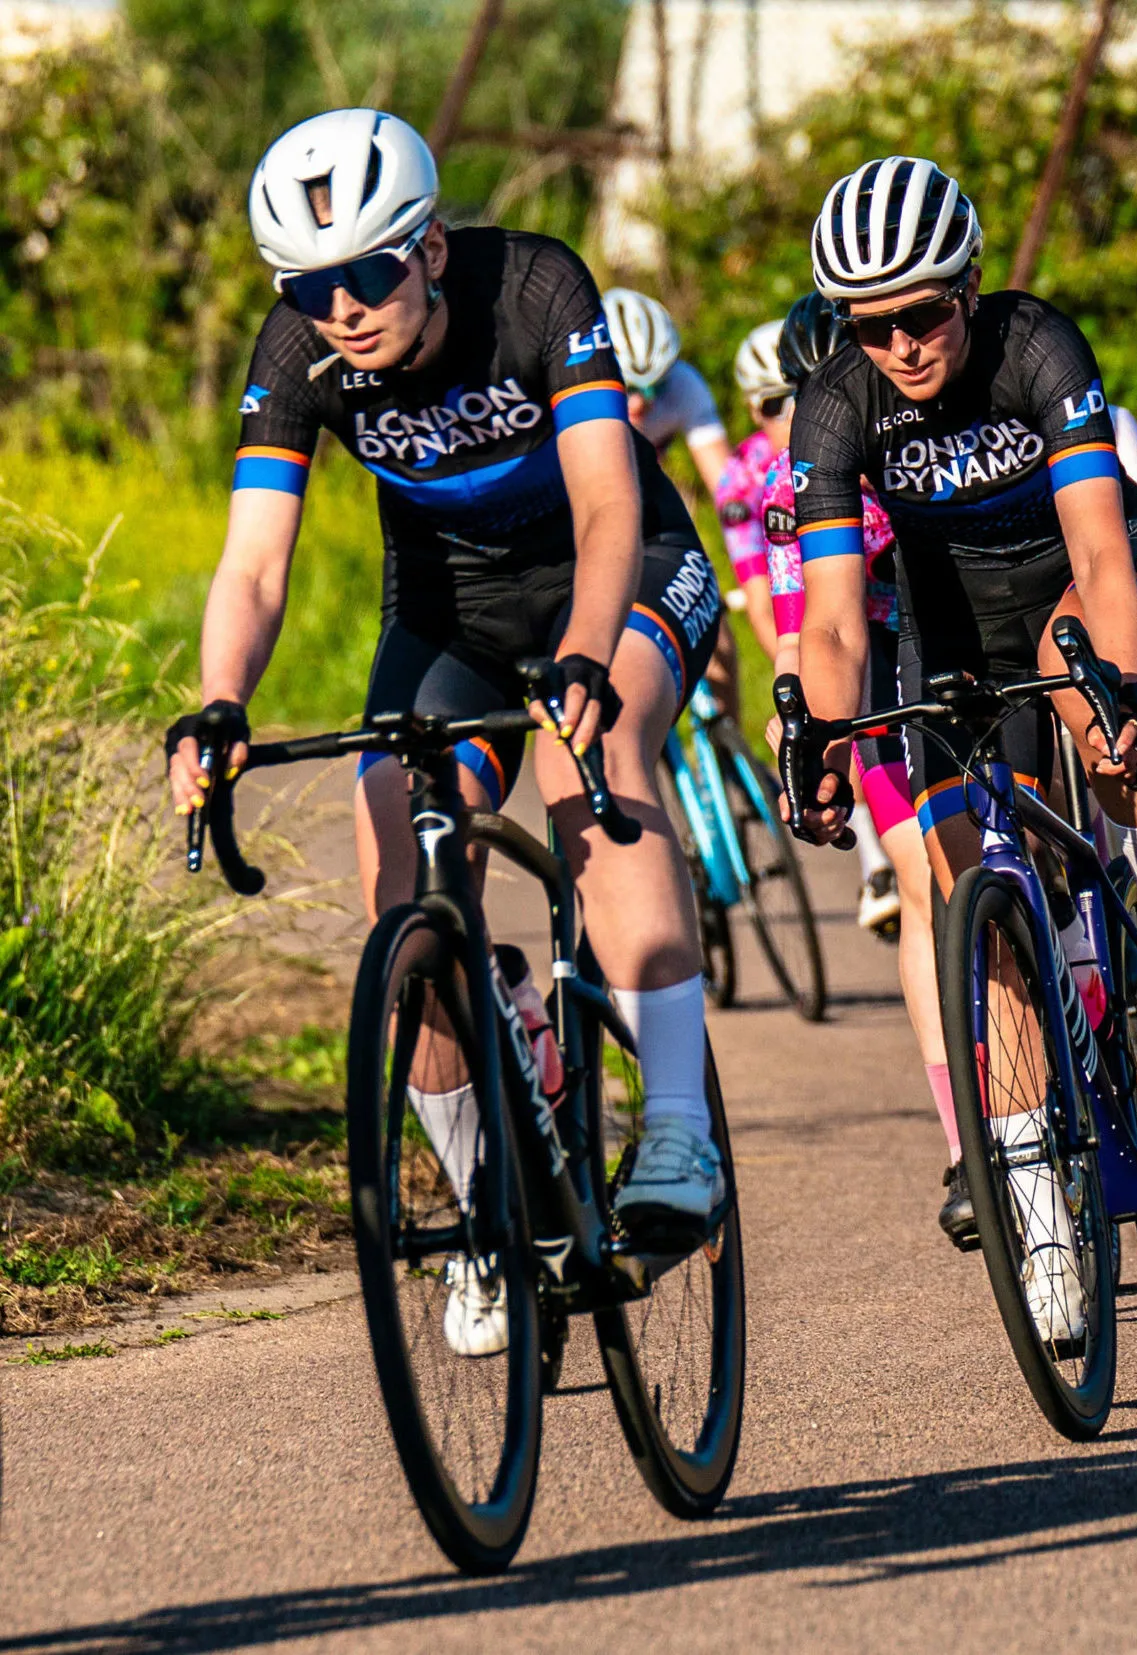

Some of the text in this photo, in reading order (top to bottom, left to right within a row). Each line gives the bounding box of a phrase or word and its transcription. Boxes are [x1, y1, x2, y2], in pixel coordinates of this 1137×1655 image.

[355, 378, 527, 437] LONDON
[358, 402, 542, 460] DYNAMO
[1063, 390, 1105, 421] LD
[884, 433, 1044, 493] DYNAMO
[885, 418, 1030, 469] LONDON
